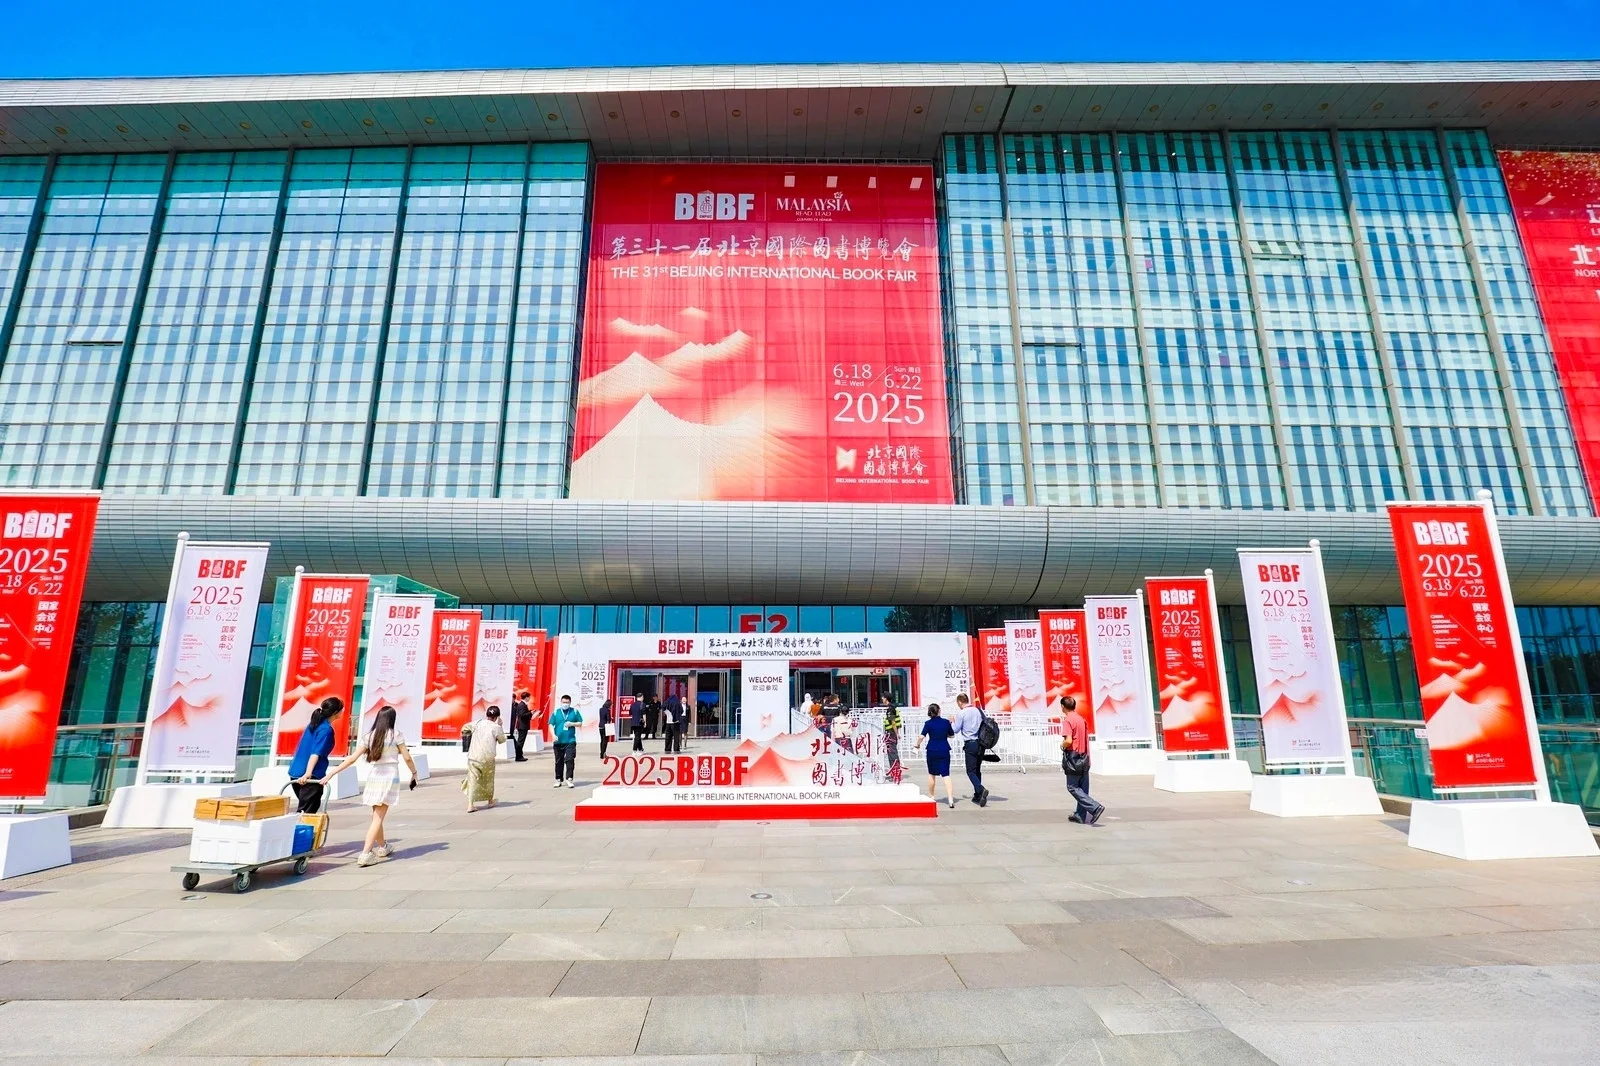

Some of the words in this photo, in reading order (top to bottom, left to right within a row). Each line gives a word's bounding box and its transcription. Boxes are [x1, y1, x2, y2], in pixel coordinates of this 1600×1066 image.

[675, 190, 755, 221] BIBF
[776, 194, 851, 211] MALAYSIA
[611, 267, 639, 279] THE
[642, 266, 669, 278] 31st
[670, 266, 723, 279] BEIJING
[727, 266, 840, 280] INTERNATIONAL
[843, 268, 885, 281] BOOK
[887, 269, 918, 282] FAIR
[833, 363, 872, 379] 6.18
[884, 374, 922, 390] 6.22
[833, 391, 925, 425] 2025
[3, 510, 74, 539] BIBF
[1412, 519, 1470, 546] BIBF
[197, 559, 248, 579] BIBF
[1418, 553, 1482, 579] 2025
[1257, 564, 1300, 582] BIBF
[27, 582, 63, 596] 6.22
[1422, 578, 1453, 591] 6.18
[190, 585, 244, 606] 2025
[311, 586, 353, 604] BIBF
[1160, 587, 1196, 606] BIBF
[1260, 589, 1309, 607] 2025
[1460, 585, 1488, 598] 6.22
[187, 605, 211, 616] 6.18
[215, 611, 239, 622] 6.22
[307, 609, 351, 625] 2025
[388, 605, 421, 619] BIBF
[1097, 606, 1128, 620] BIBF
[1263, 608, 1285, 617] 6.18
[1290, 612, 1312, 622] 6.22
[35, 612, 57, 623] 会议
[1049, 618, 1076, 630] BIBF
[1161, 610, 1200, 626] 2025
[33, 623, 55, 634] 中心
[221, 625, 237, 633] 国家
[305, 624, 324, 633] 6.18
[384, 623, 420, 637] 2025
[441, 618, 471, 631] BIBF
[1097, 624, 1131, 637] 2025
[1162, 626, 1181, 634] 6.18
[1476, 623, 1494, 634] 中心
[220, 633, 235, 642] 会议
[327, 629, 348, 638] 6.22
[484, 628, 508, 640] BIBF
[1014, 628, 1037, 638] BIBF
[1050, 634, 1079, 645] 2025
[1184, 630, 1201, 638] 6.22
[218, 642, 233, 651] 中心
[438, 634, 470, 647] 2025
[482, 642, 508, 652] 2025
[658, 638, 694, 655] BIBF
[837, 640, 872, 650] MALAYSIA
[1014, 642, 1040, 652] 2025
[1304, 641, 1316, 649] 中心
[582, 671, 606, 680] 2025
[944, 670, 968, 678] 2025
[674, 793, 688, 801] THE
[690, 793, 704, 801] 31st
[706, 793, 735, 801] BEIJING
[736, 792, 798, 801] INTERNATIONAL
[799, 792, 821, 800] BOOK
[823, 792, 841, 800] FAIR
